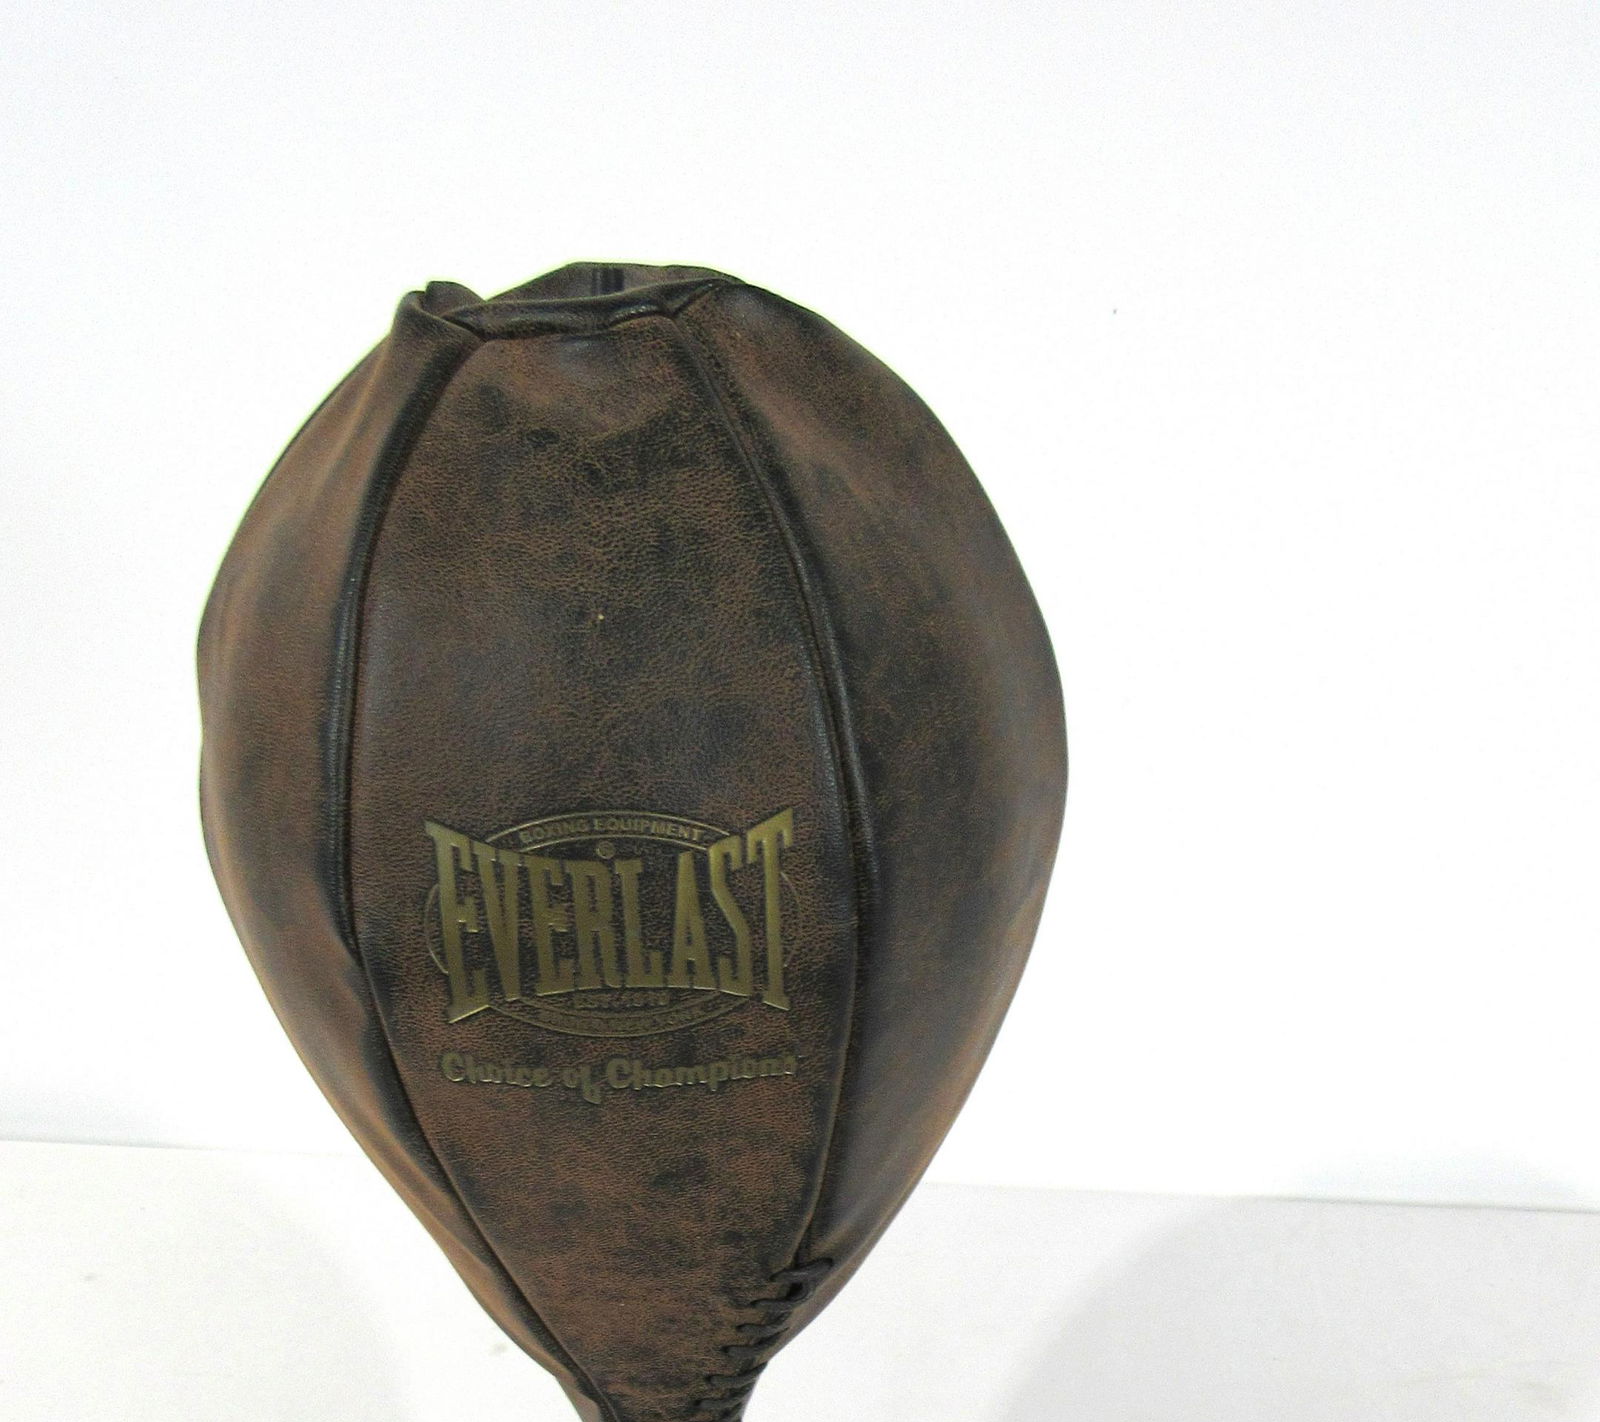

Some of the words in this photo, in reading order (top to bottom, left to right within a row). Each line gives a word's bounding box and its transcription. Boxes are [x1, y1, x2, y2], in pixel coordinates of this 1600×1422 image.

[518, 819, 590, 844] BOXING
[593, 818, 706, 842] EQUIPMENT
[425, 808, 793, 1024] EVERLAST
[441, 1052, 552, 1088] Choice
[562, 1063, 601, 1105] of
[605, 1056, 797, 1093] Champions
